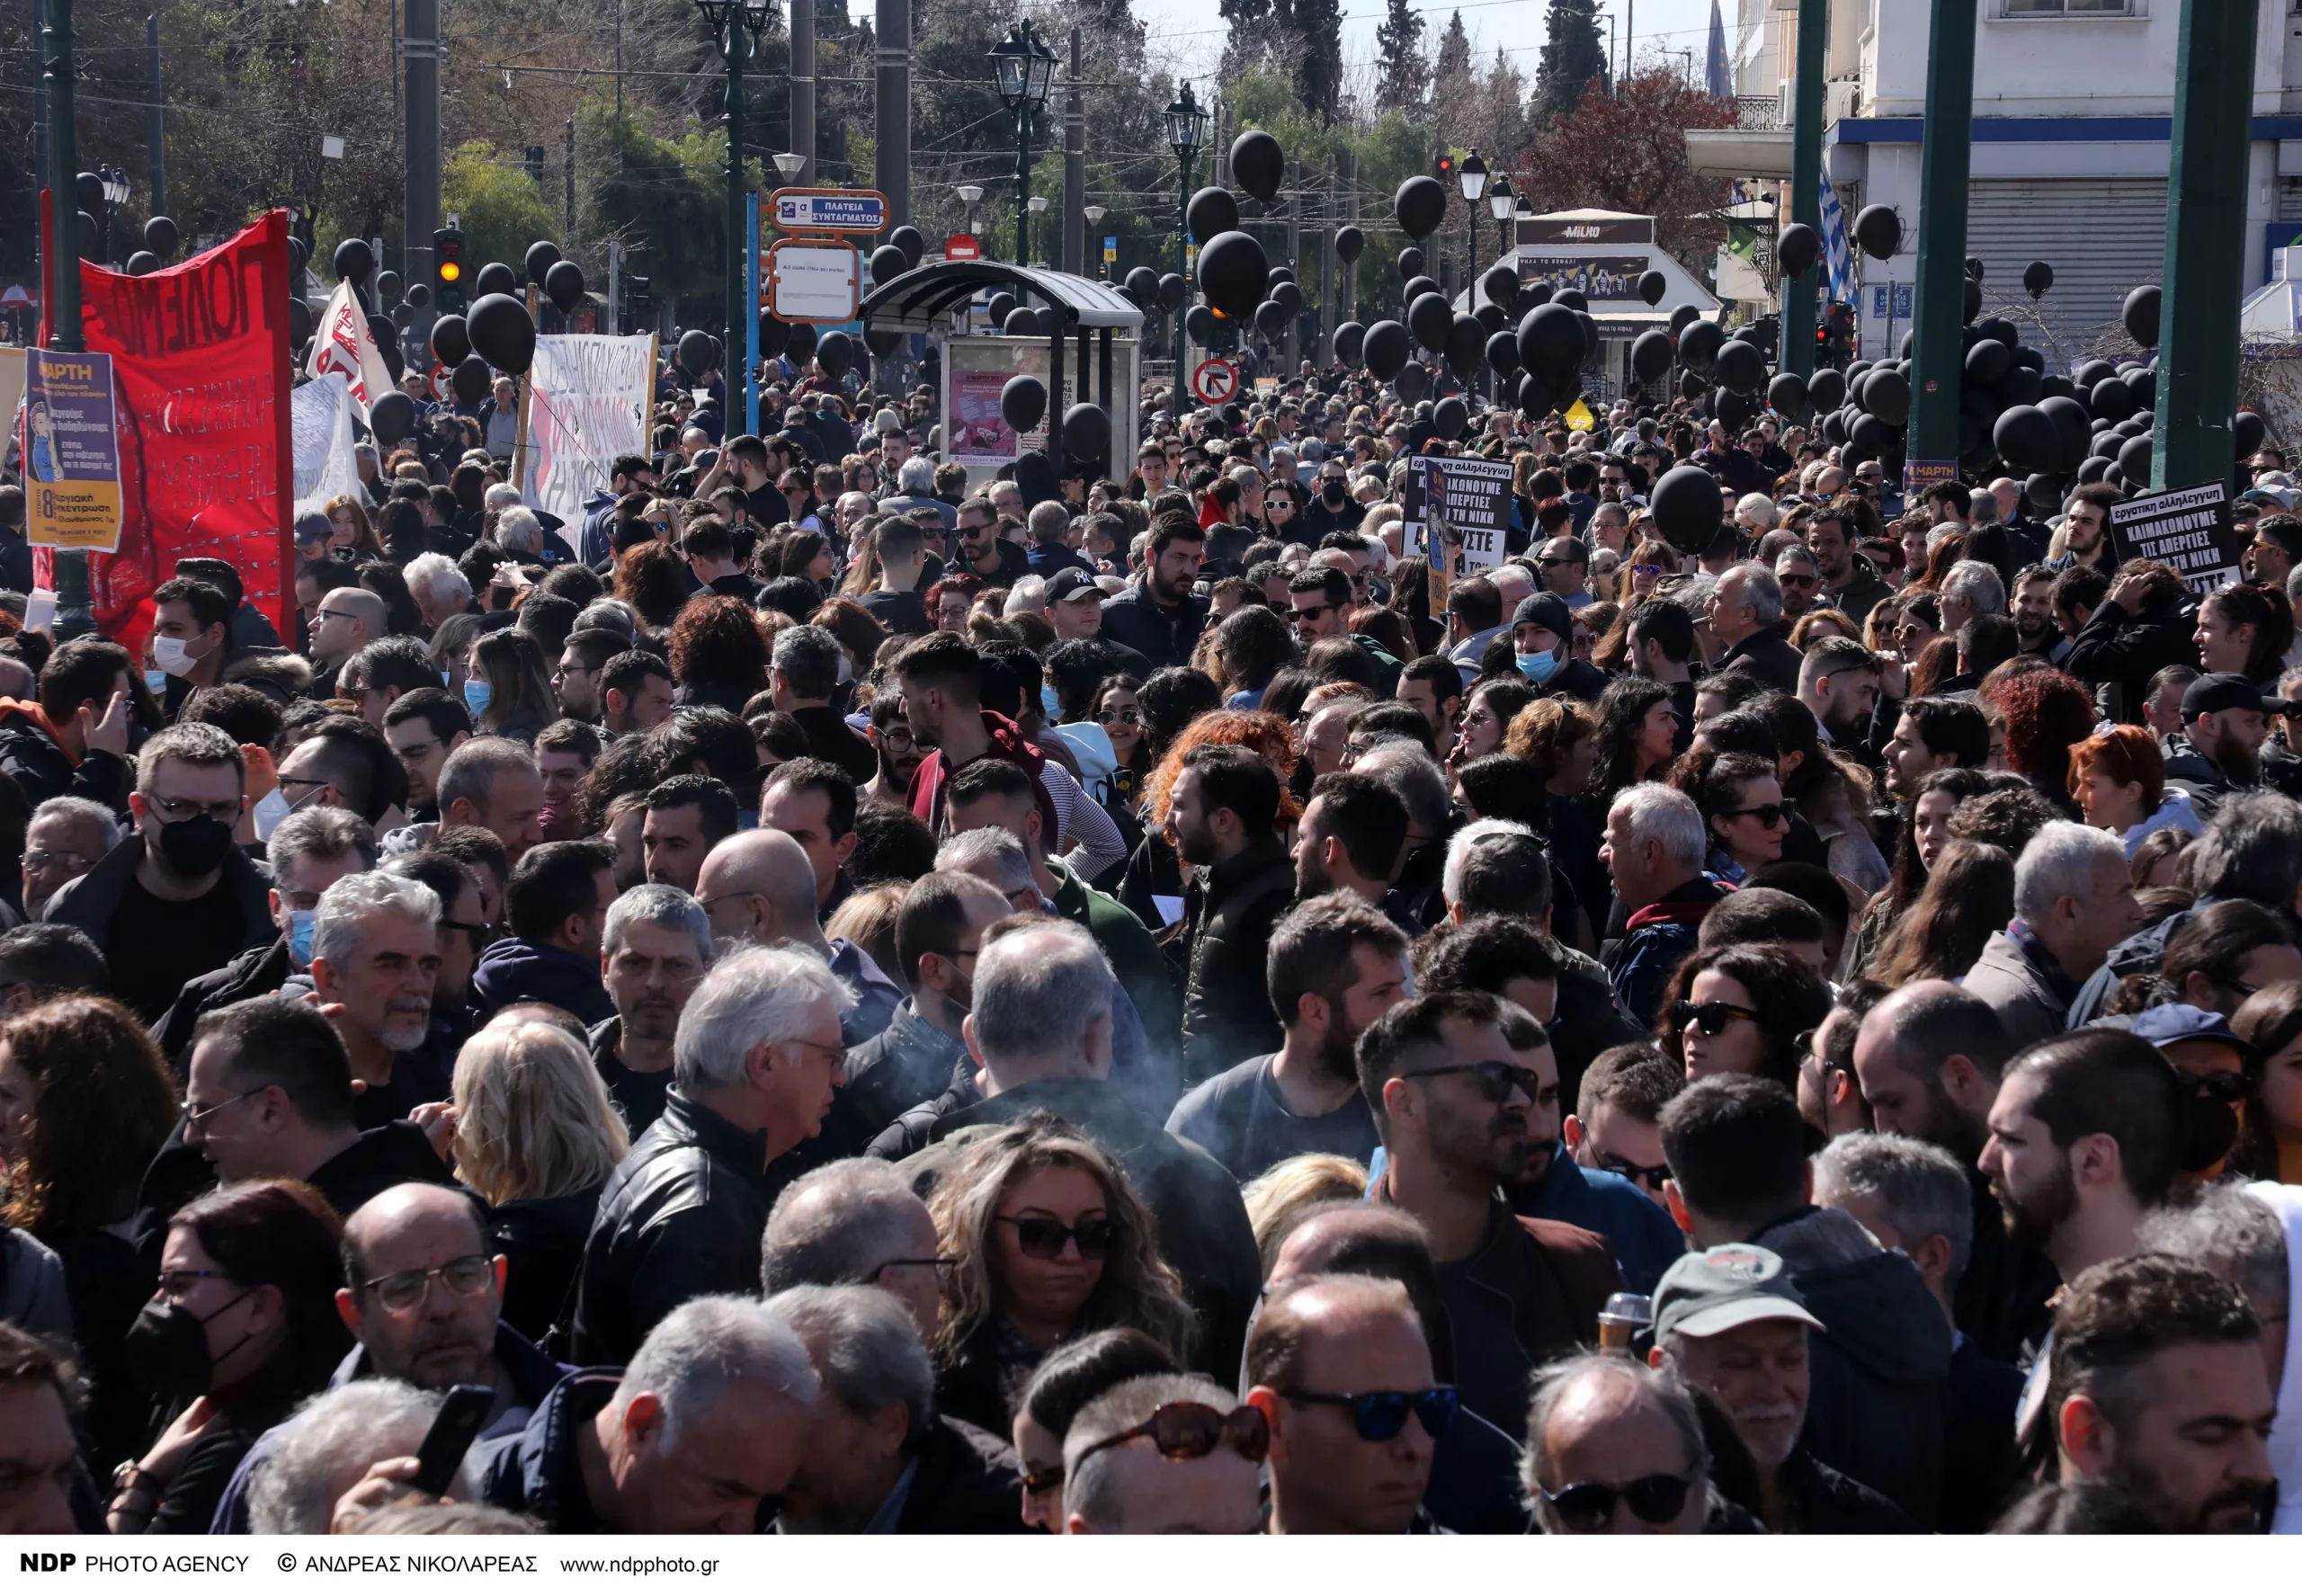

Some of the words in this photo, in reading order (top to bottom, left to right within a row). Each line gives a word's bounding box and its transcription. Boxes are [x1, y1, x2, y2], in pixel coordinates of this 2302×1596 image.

[825, 202, 863, 211] ΠΛΑΤΕΙΑ
[813, 212, 879, 223] ΣΥΝΤΑΓΜΑΤΟΣ
[1455, 464, 1510, 477] αλληλεγγυη
[1910, 466, 1914, 476] 8
[1916, 467, 1955, 477] ΜΑΡΤΗ
[43, 489, 53, 519] 8
[2115, 502, 2157, 520] εργατικη
[2159, 489, 2220, 509] αλληλεγγυη
[1453, 510, 1466, 522] ΤΗ
[1469, 511, 1495, 524] ΝΙΚΗ
[2126, 510, 2218, 542] ΚΛΙΜΑΚΩΝΟΥΜΕ
[2140, 541, 2158, 558] ΤΙΣ
[2160, 531, 2210, 555] ΑΠΕΡΓΙΕΣ
[2190, 548, 2221, 567] ΝΙΚΗ
[1074, 571, 1091, 583] NY
